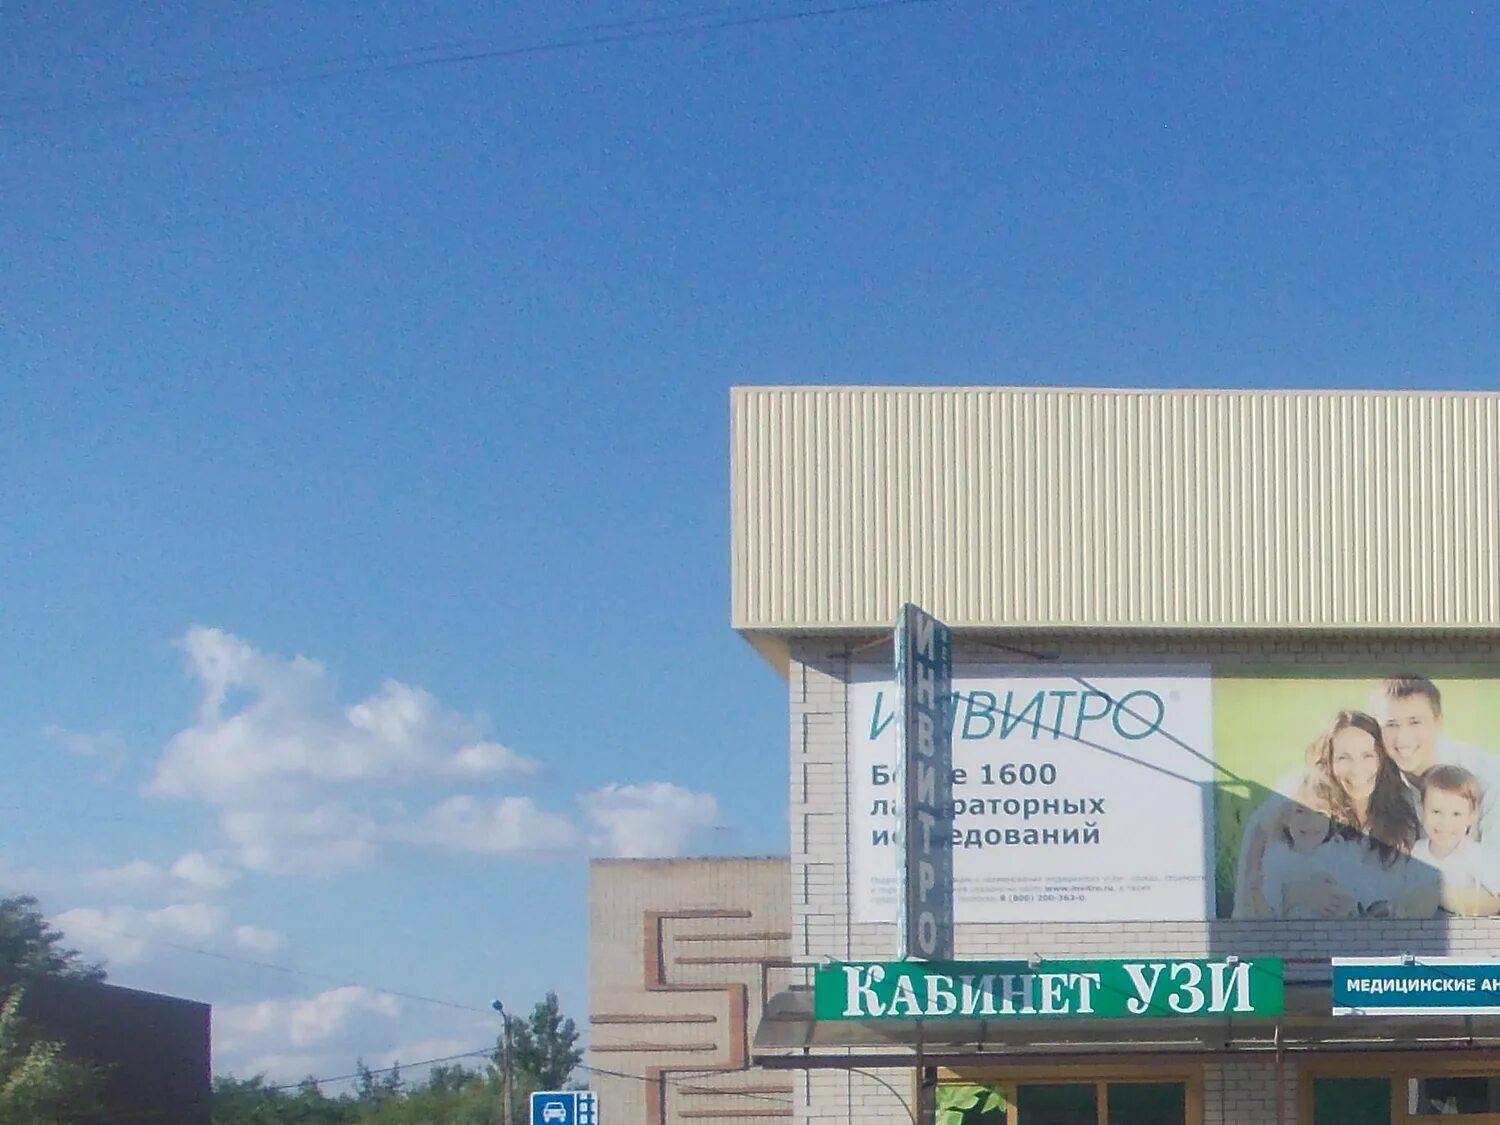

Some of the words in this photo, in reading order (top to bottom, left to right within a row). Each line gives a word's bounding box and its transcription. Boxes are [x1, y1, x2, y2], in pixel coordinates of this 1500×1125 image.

[869, 689, 1165, 741] ИВИТРО
[916, 611, 937, 955] ИНВИТРО
[979, 763, 1057, 786] 1600
[870, 797, 1106, 821] лраторных
[872, 822, 1101, 849] иедований
[842, 965, 1101, 1017] КАБИНЕТ
[1123, 960, 1255, 1015] УЗИ
[1347, 978, 1476, 994] МЕДИЦИНСКИЕ
